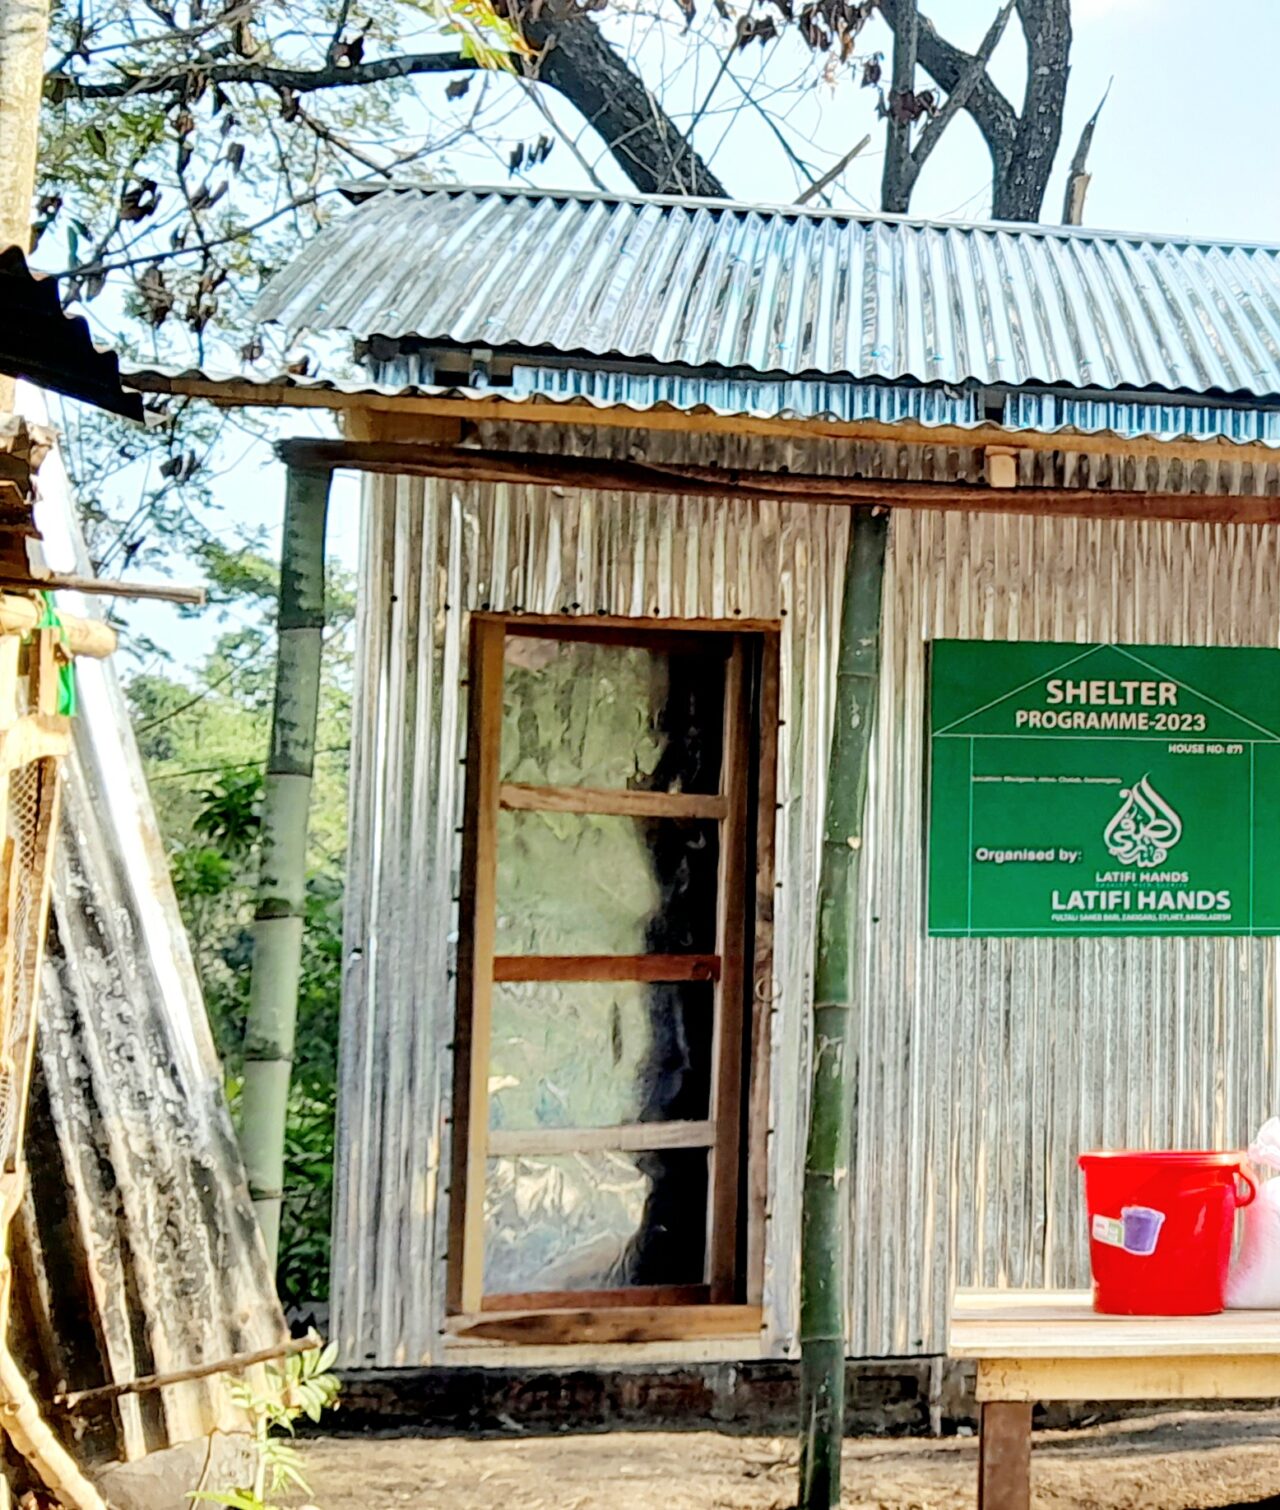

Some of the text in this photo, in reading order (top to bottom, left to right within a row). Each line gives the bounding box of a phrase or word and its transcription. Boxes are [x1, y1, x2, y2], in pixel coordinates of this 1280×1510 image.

[1046, 679, 1177, 706] SHELTER
[1015, 710, 1206, 731] PROGRAMME-2023
[1168, 743, 1205, 754] HOUSE
[975, 847, 1082, 864] Organised by:
[1095, 871, 1189, 883] LATIFI HANDS
[1052, 890, 1231, 910] LATIFI HANDS
